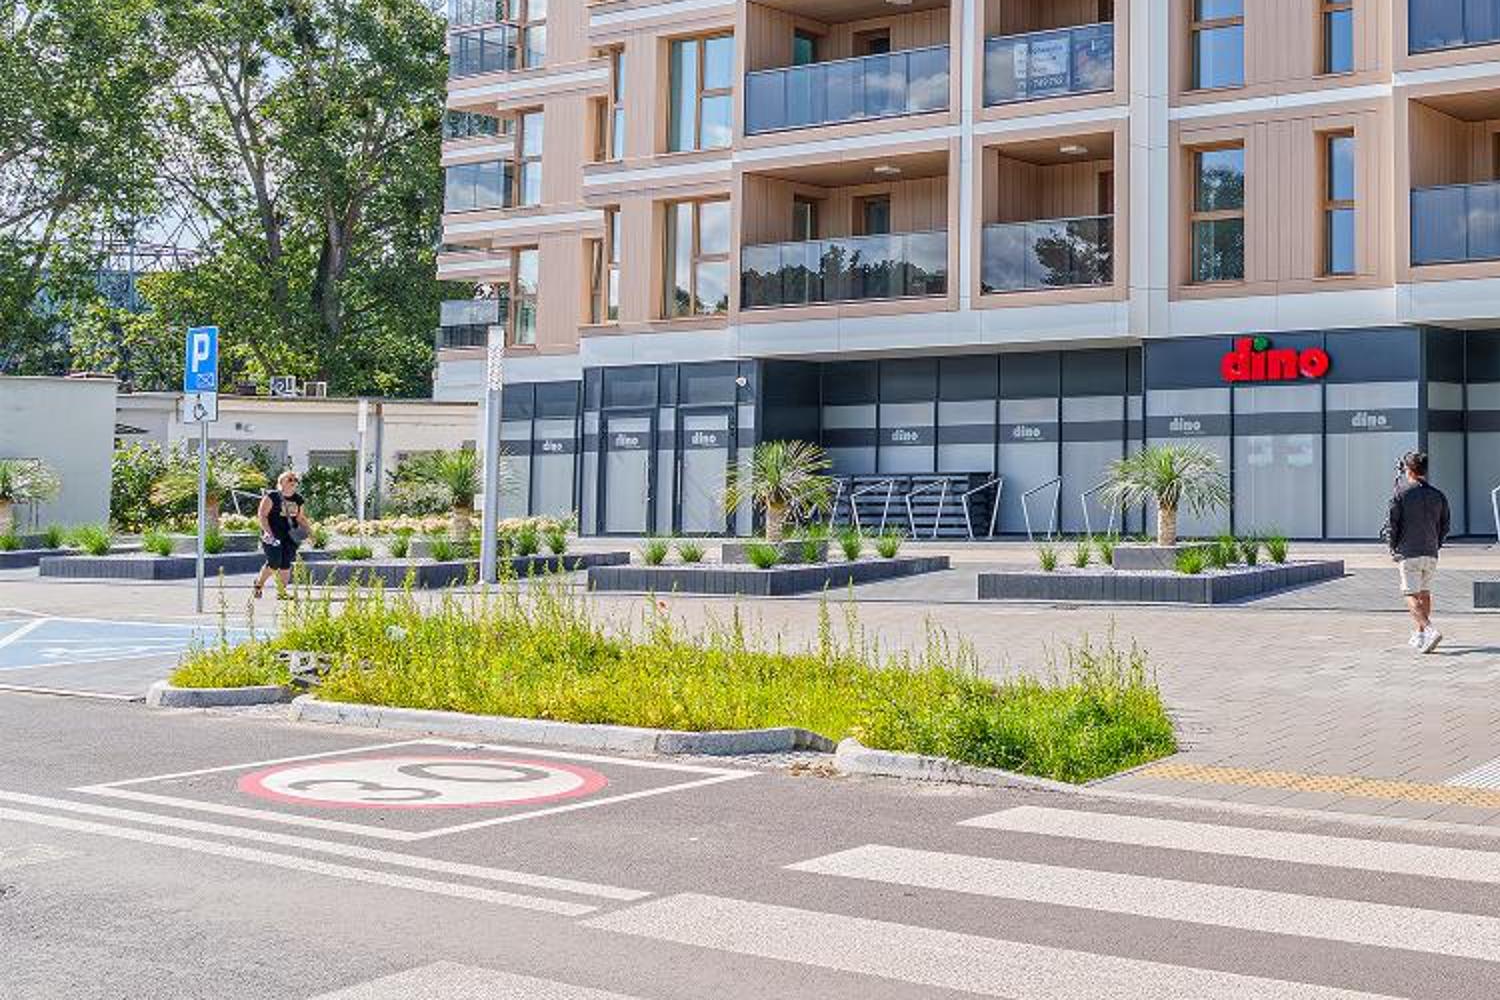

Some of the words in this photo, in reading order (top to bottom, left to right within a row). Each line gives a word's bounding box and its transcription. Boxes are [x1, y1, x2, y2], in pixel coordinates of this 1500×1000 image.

[191, 333, 210, 373] P
[1221, 335, 1329, 382] dino
[1169, 416, 1201, 432] dino
[1351, 411, 1387, 427] dino
[691, 431, 717, 445] dino
[891, 429, 919, 442] dino
[1012, 424, 1041, 438] dino
[288, 762, 550, 802] 30
